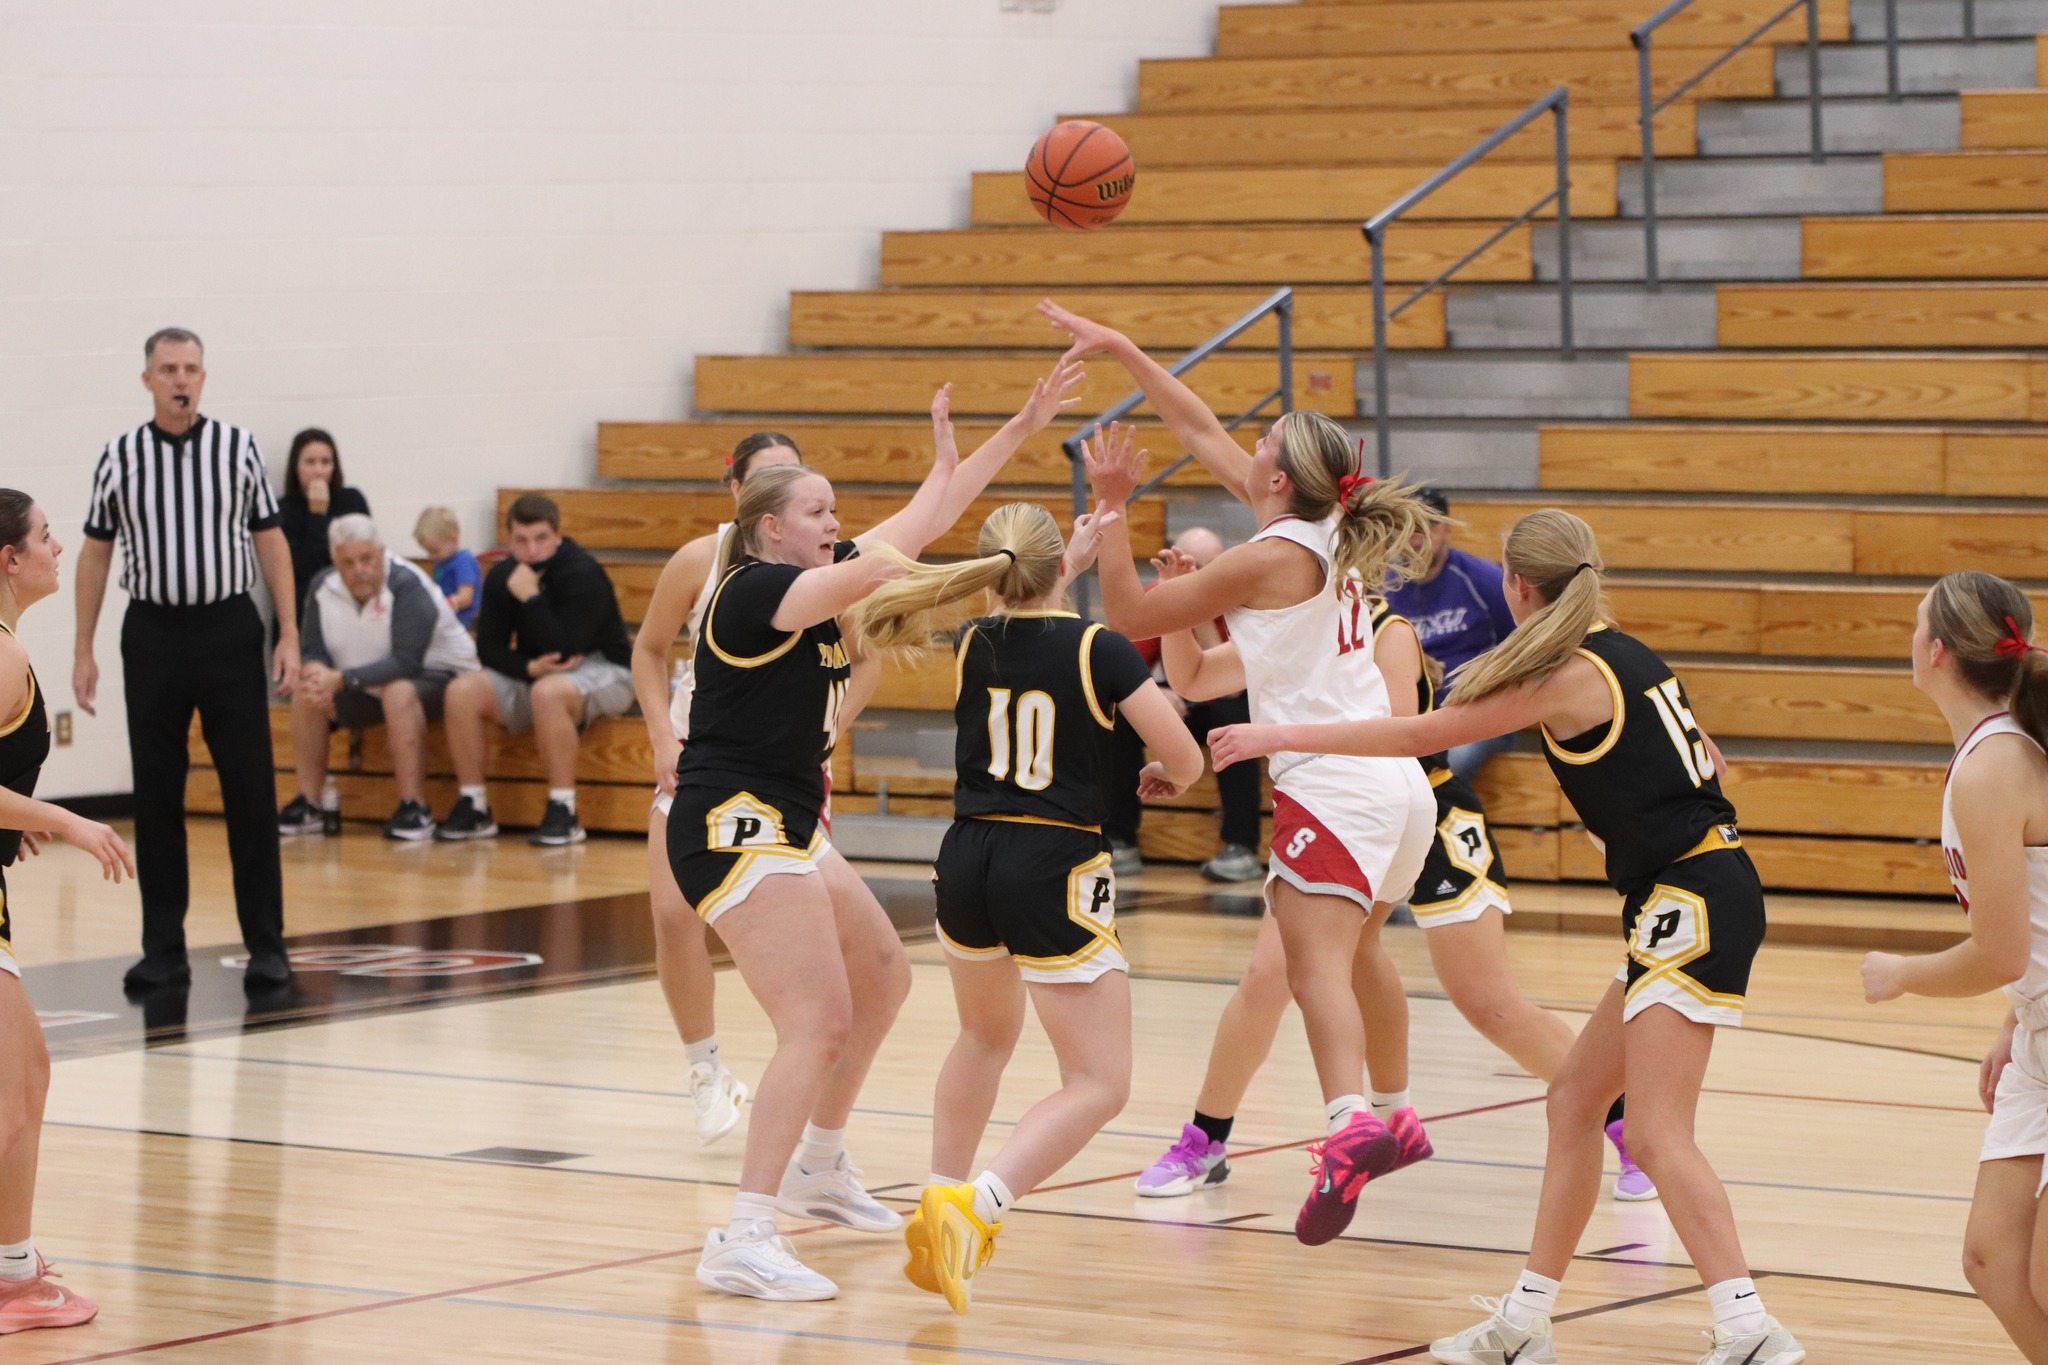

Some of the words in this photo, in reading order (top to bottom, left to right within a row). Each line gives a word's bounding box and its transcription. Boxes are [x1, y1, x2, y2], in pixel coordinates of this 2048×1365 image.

[986, 687, 1056, 791] 10
[1643, 676, 1716, 788] 15
[731, 816, 761, 846] P
[1285, 826, 1317, 859] S
[1456, 826, 1482, 857] P
[1090, 877, 1111, 913] P
[1646, 908, 1681, 949] P
